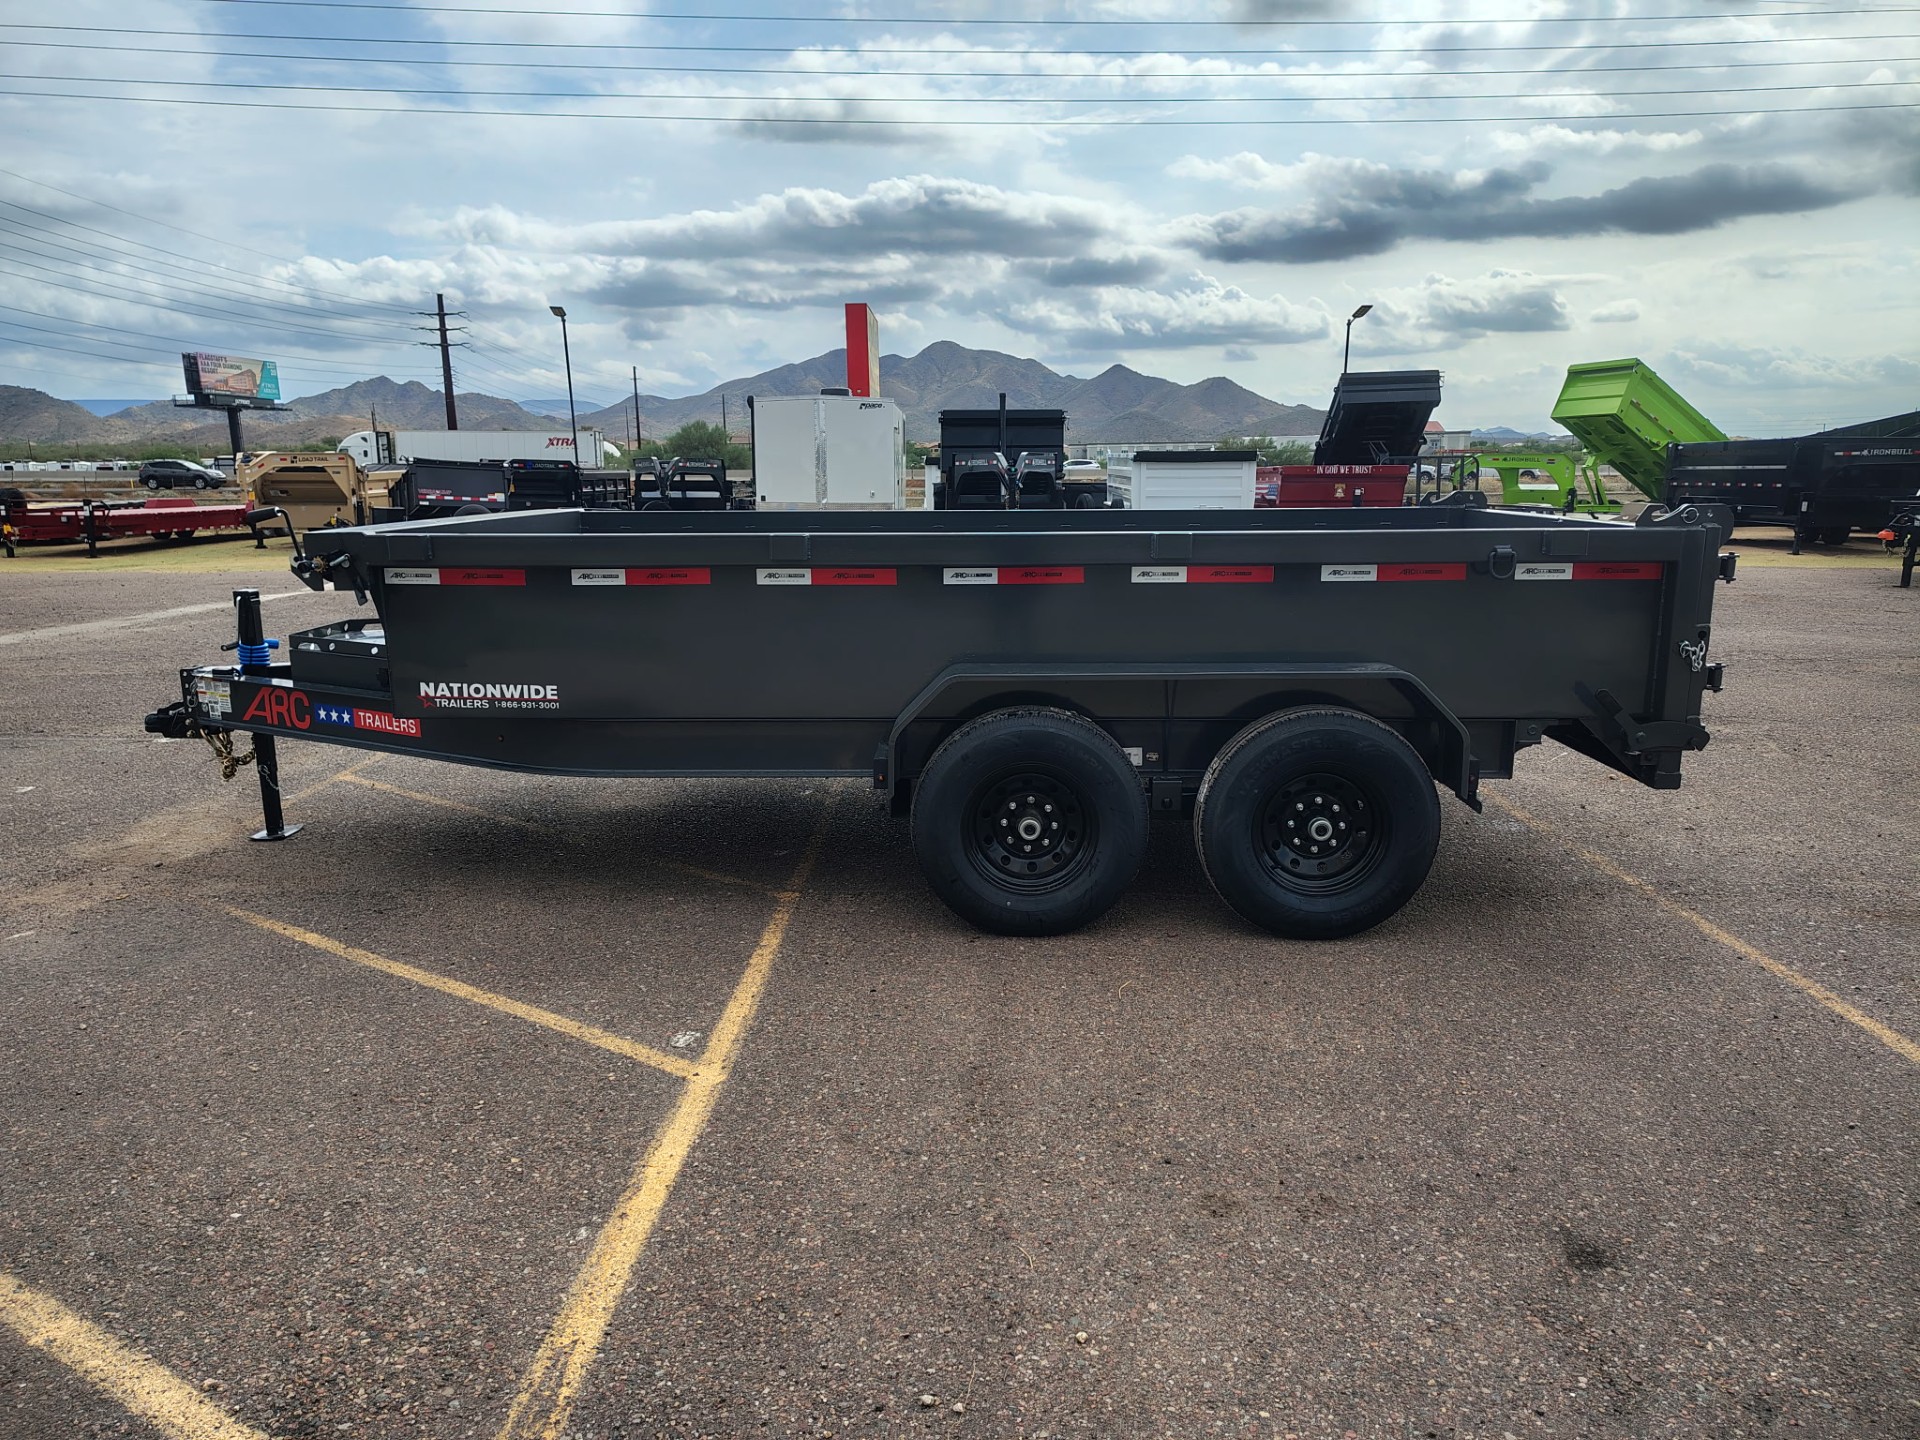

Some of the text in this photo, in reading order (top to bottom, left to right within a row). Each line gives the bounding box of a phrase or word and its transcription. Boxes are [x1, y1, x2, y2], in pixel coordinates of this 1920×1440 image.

[1316, 465, 1373, 474] IN GOD WE TRUST
[419, 682, 558, 699] NATIONWIDE
[243, 686, 311, 730] ARC
[358, 711, 416, 734] TRAILERS
[434, 698, 560, 710] TRAILERS 1-866-931-3001
